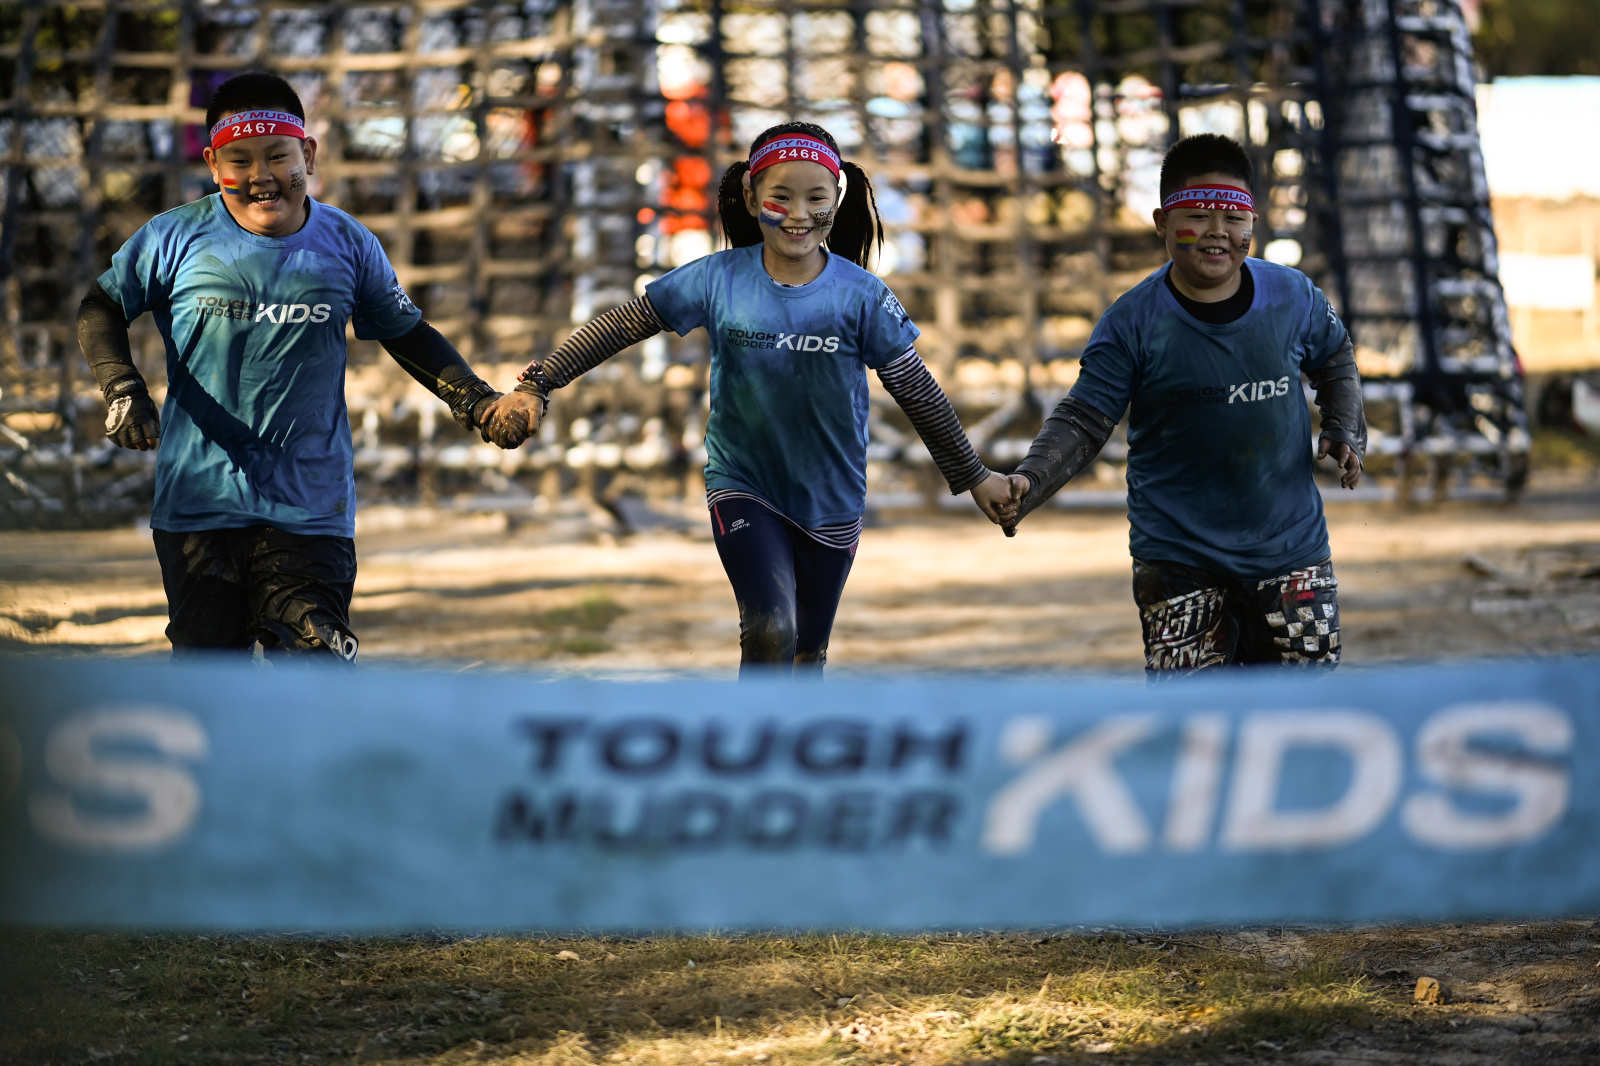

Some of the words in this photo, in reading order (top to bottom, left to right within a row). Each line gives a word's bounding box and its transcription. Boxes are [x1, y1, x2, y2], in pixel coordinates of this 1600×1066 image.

[232, 123, 276, 137] 2467
[778, 148, 819, 161] 2468
[195, 296, 255, 310] TOUGH
[196, 306, 253, 321] MUDDER
[255, 303, 332, 324] KIDS
[727, 337, 775, 350] MUDDER
[728, 328, 777, 341] TOUGH
[776, 332, 841, 353] KIDS
[1227, 375, 1290, 405] KIDS
[511, 714, 970, 778] TOUGH
[977, 698, 1575, 857] KIDS
[489, 788, 963, 854] MUDDER
